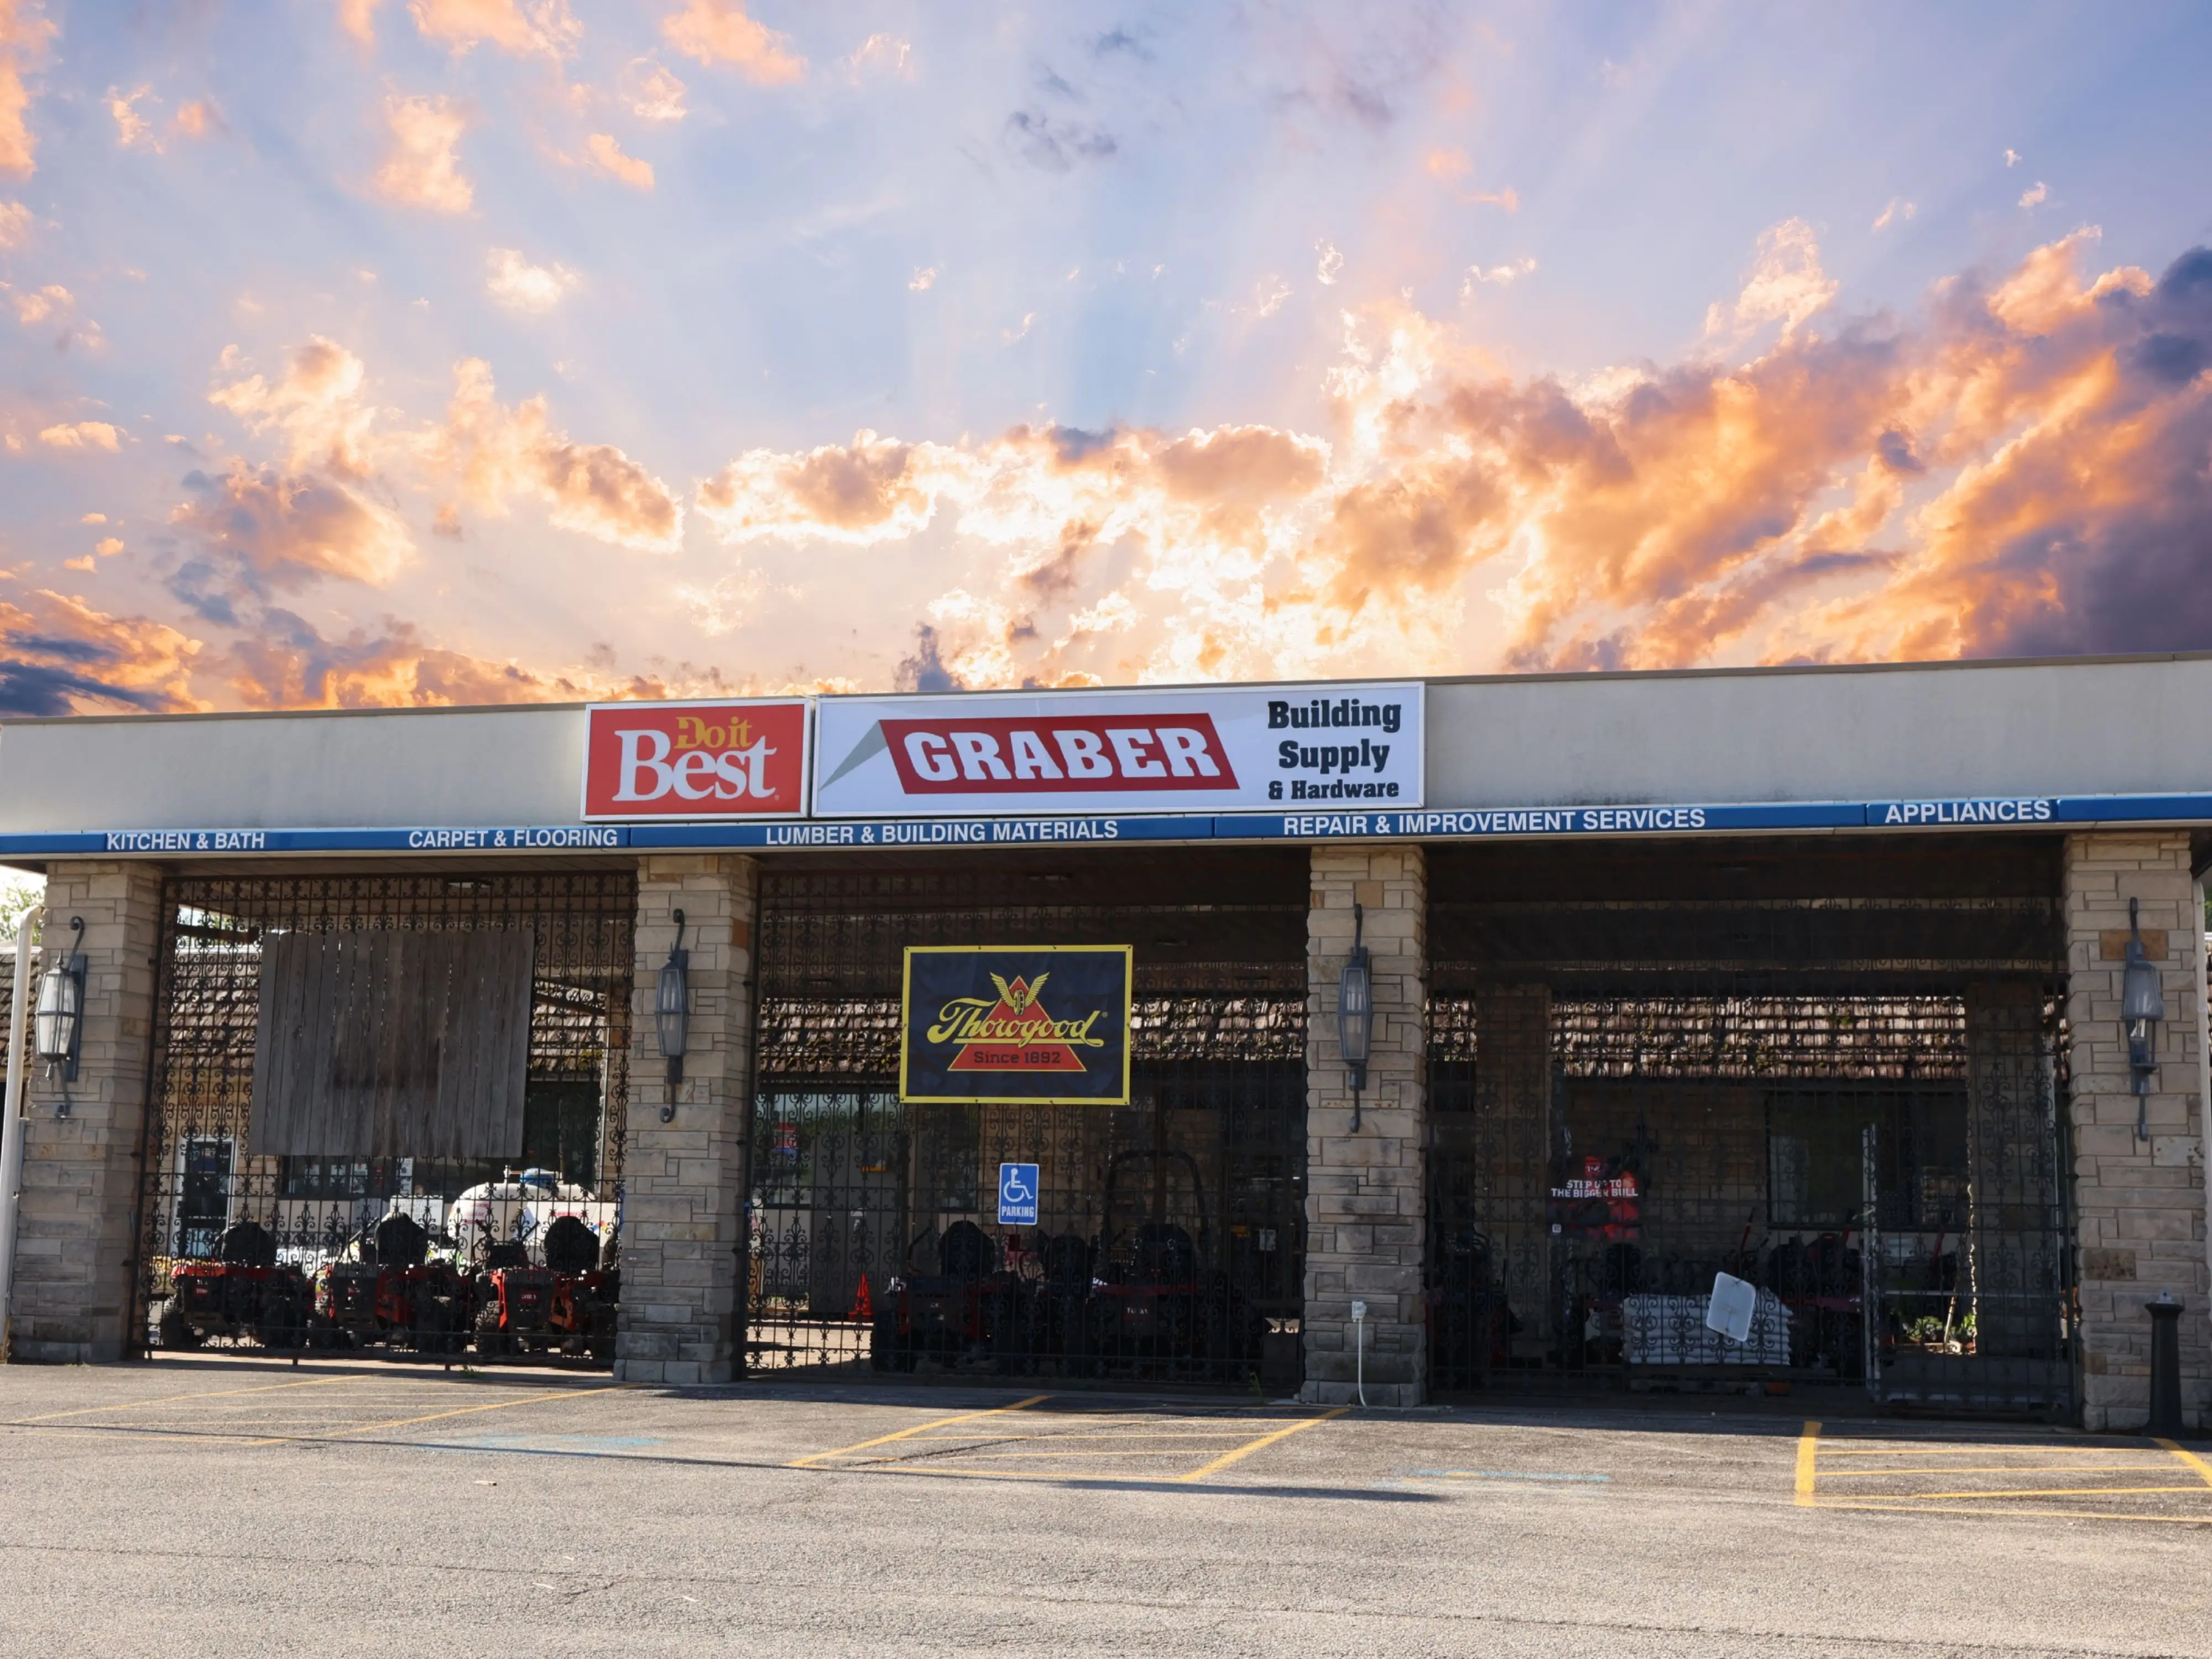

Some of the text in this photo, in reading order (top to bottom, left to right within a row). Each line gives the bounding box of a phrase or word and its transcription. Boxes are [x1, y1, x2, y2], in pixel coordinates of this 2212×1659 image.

[1268, 699, 1401, 733] Building
[612, 729, 777, 801] Best
[903, 727, 1221, 781] GRABER
[1279, 738, 1390, 774] Supply
[1269, 779, 1399, 800] & Hardware
[1284, 809, 1706, 836] REPAIR & IMPROVEMENT SERVICES
[1885, 800, 2051, 823] APPLIANCES
[107, 833, 265, 850] KITCHEN & BATH
[408, 828, 618, 848] CARPET & FLOORING
[766, 820, 1118, 844] LUMBER & BUILDING MATERIALS
[927, 997, 1104, 1048] Thorogood
[974, 1051, 1061, 1063] Since 1892
[1551, 1188, 1639, 1198] THE BIGGER BULL
[1610, 1179, 1621, 1188] TO
[1001, 1206, 1035, 1217] PARKING
